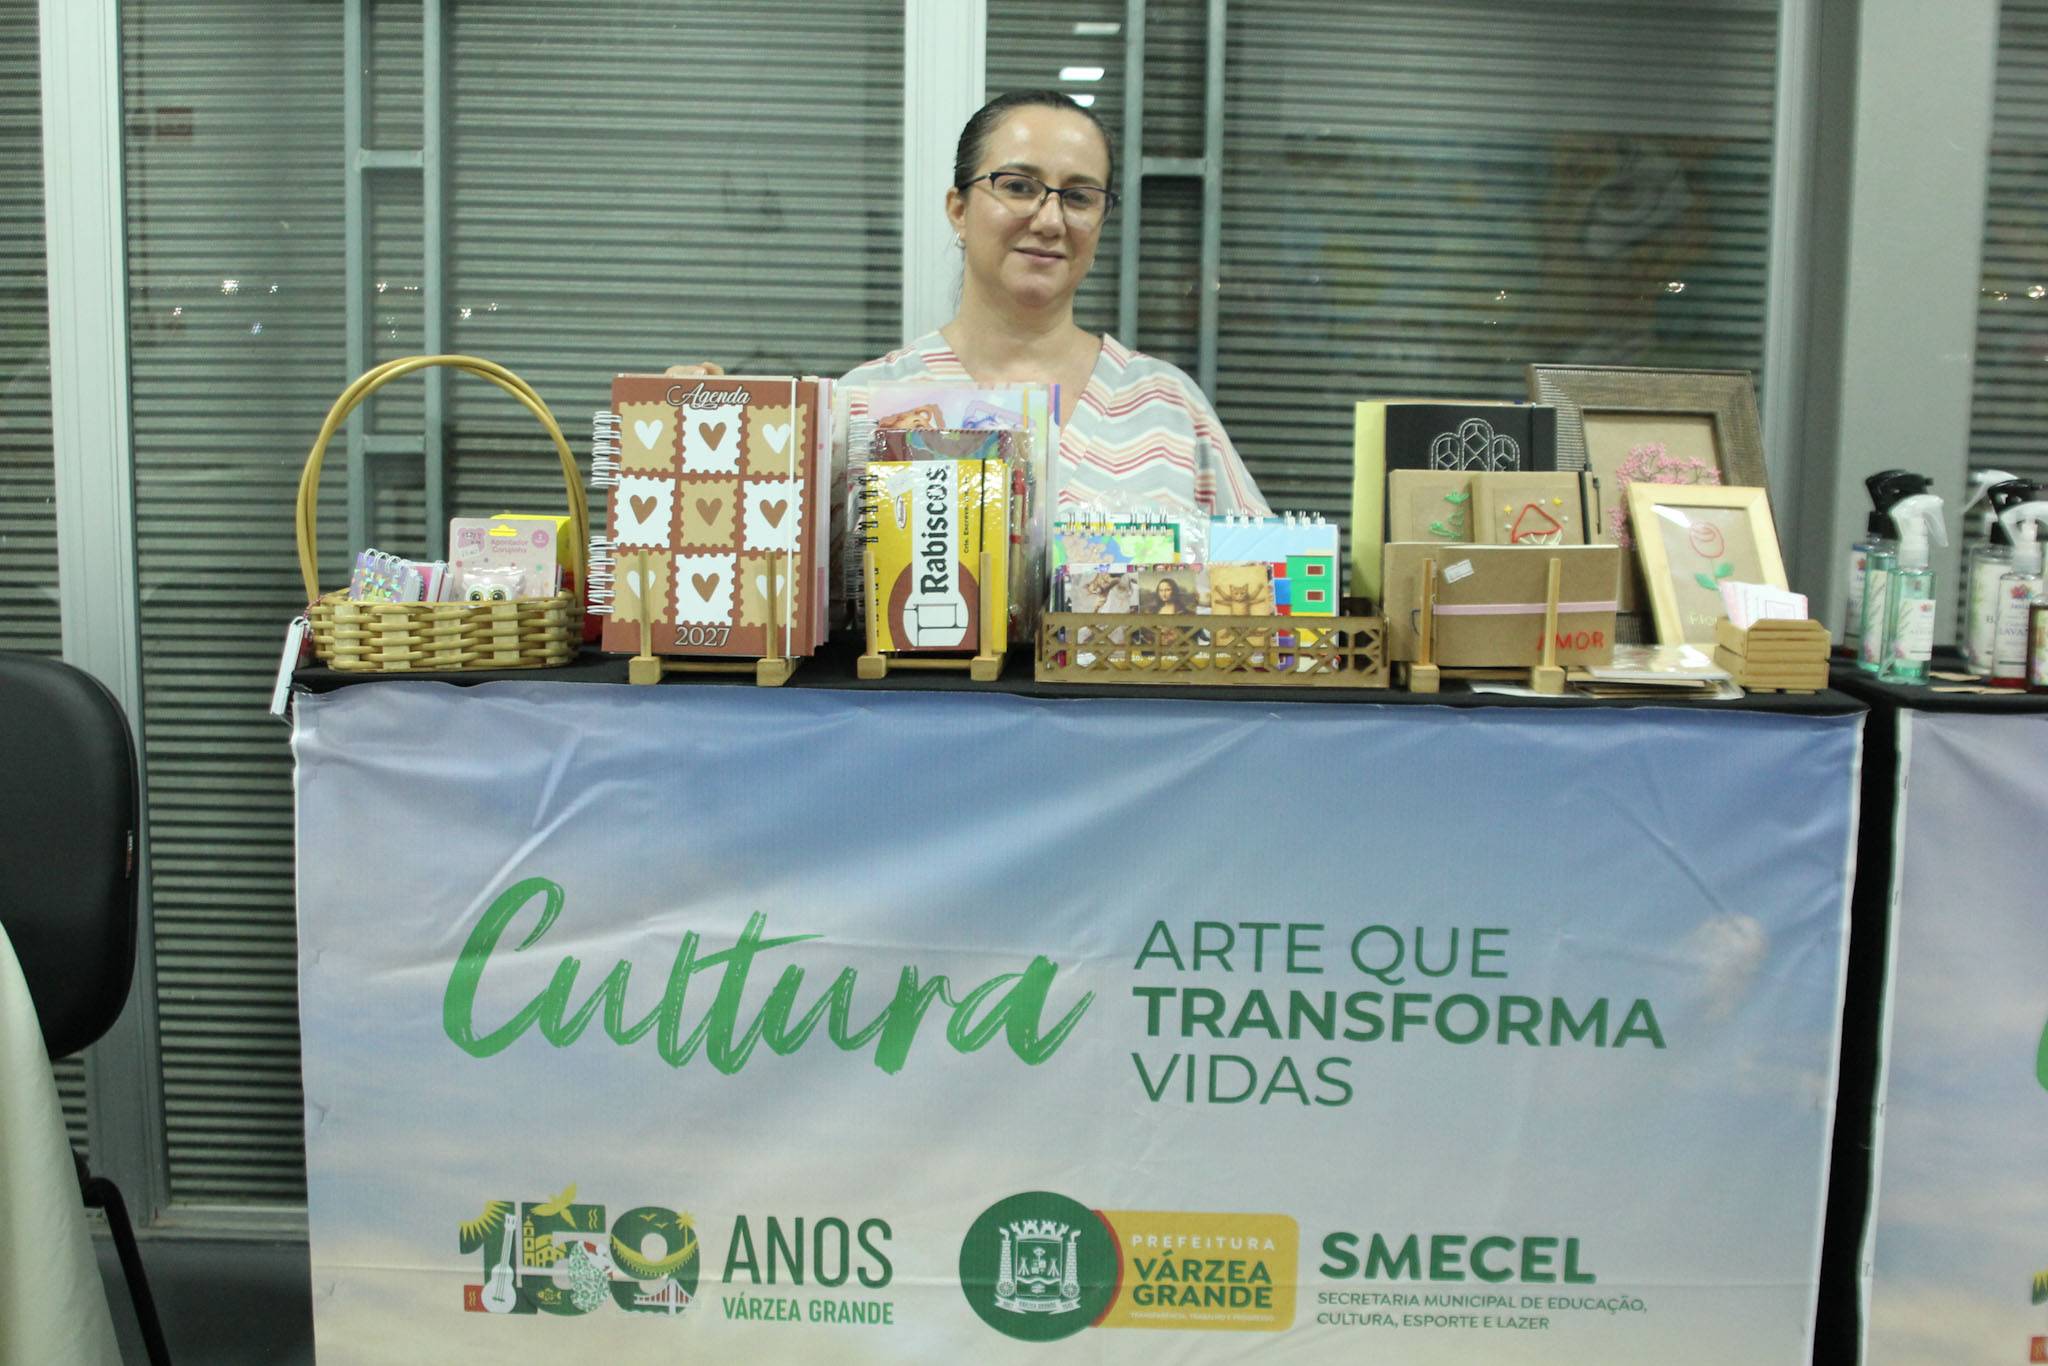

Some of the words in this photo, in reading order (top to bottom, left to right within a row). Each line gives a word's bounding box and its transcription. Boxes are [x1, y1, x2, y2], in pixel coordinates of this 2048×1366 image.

[666, 382, 752, 410] Agenda
[919, 466, 951, 595] Rabiscos
[674, 625, 730, 647] 2027
[1133, 919, 1325, 975] ARTE
[1350, 924, 1510, 986] QUE
[443, 876, 1096, 1075] Cultura
[1131, 986, 1667, 1049] TRANSFORMA
[1131, 1052, 1354, 1107] VIDAS
[722, 1214, 893, 1289] ANOS
[1131, 1233, 1276, 1251] PREFEITURA
[1318, 1231, 1597, 1285] SMECEL
[1133, 1249, 1272, 1285] VÁRZEA
[722, 1291, 801, 1322] VÁRZEA
[809, 1299, 894, 1326] GRANDE
[1133, 1284, 1273, 1309] GRANDE
[1317, 1291, 1421, 1307] SECRETARIA
[1423, 1294, 1516, 1309] MUNICIPAL
[1520, 1296, 1543, 1309] DE
[1547, 1295, 1648, 1315] EDUCAÇÃO,
[1316, 1312, 1399, 1328] CULTURA,
[1403, 1314, 1478, 1328] ESPORTE
[1482, 1315, 1492, 1329] E
[1496, 1316, 1551, 1330] LAZER
